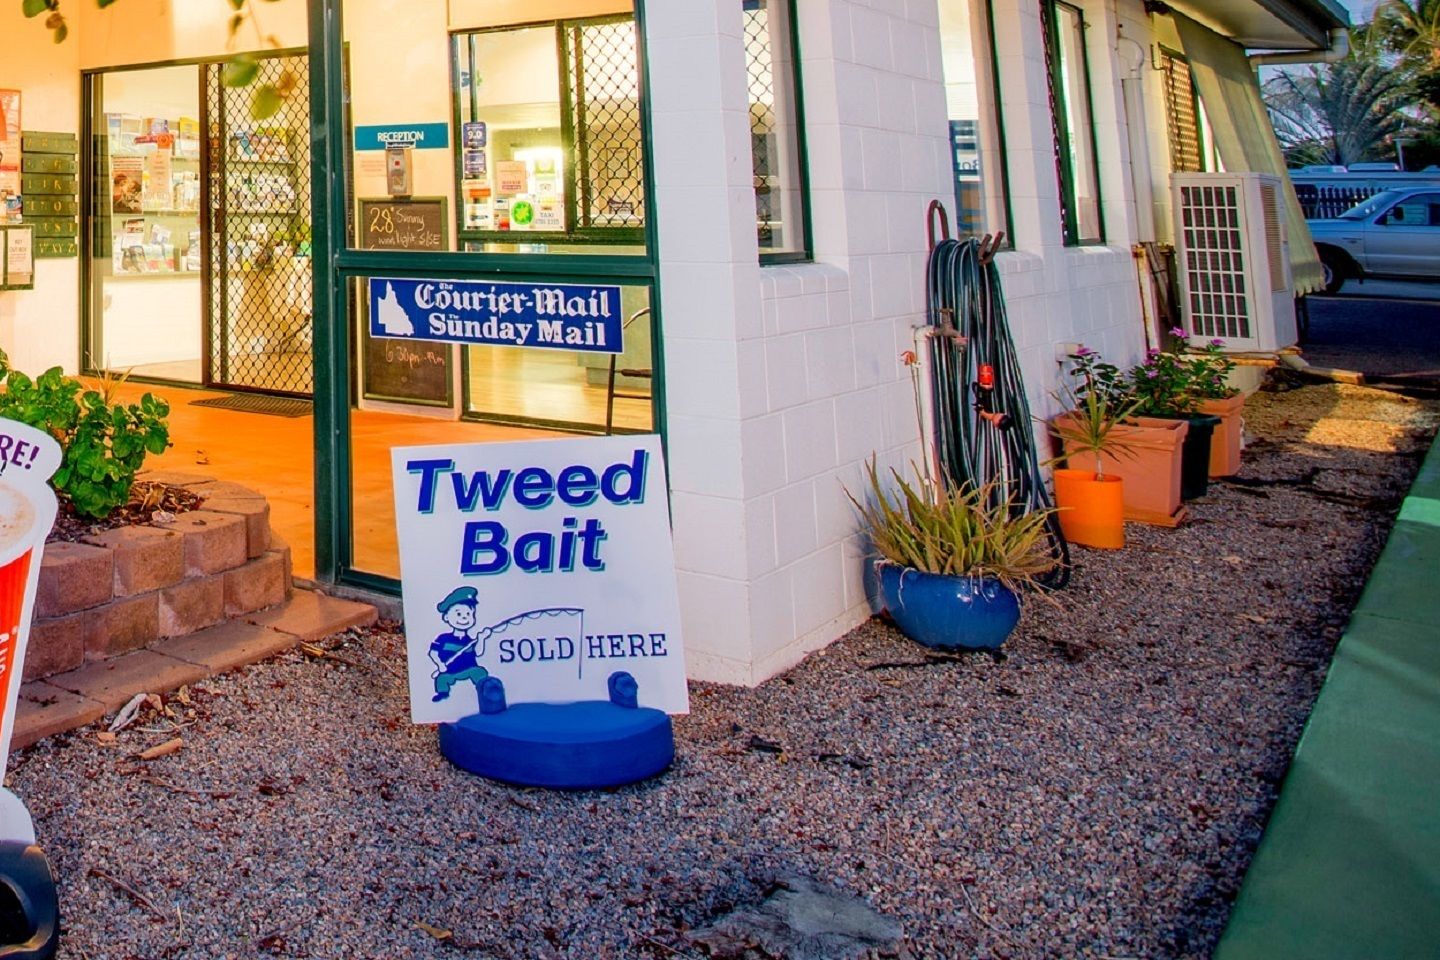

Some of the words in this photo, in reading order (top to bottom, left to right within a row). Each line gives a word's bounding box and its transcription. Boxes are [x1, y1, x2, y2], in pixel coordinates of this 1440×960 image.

[377, 131, 424, 142] RECEPTION
[396, 208, 425, 231] Sunny
[414, 284, 611, 318] Courier-Mail
[428, 312, 533, 345] Sunday
[537, 319, 606, 346] Mail
[406, 449, 649, 515] Tweed
[460, 516, 608, 576] Bait
[499, 637, 574, 664] SOLD
[585, 633, 668, 659] HERE
